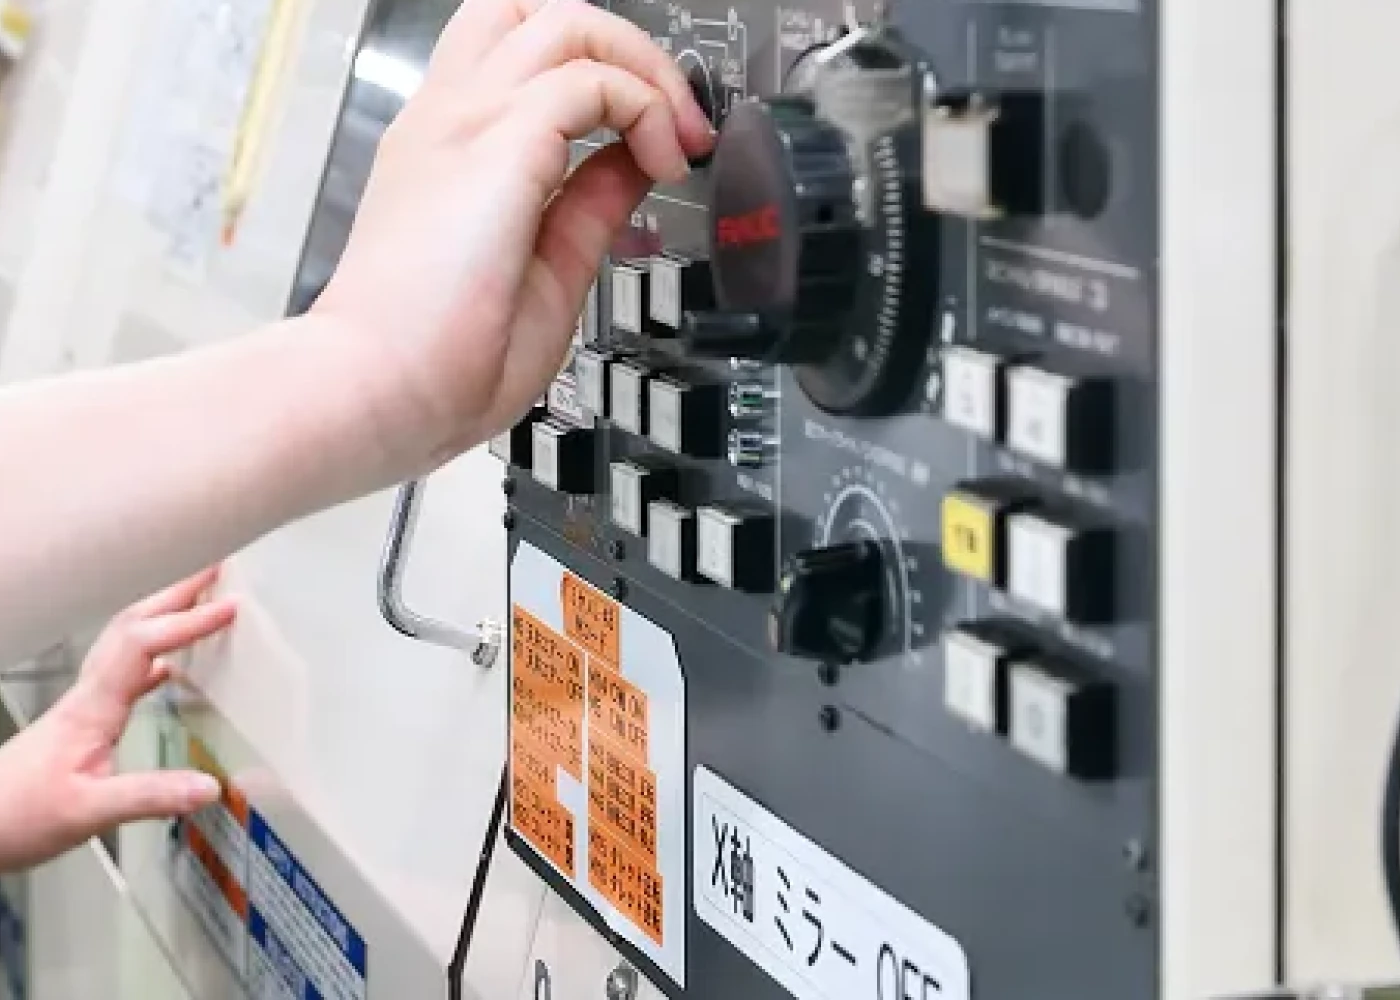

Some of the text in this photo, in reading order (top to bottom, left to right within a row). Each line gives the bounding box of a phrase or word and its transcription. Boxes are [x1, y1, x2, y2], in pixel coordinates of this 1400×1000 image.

[711, 812, 753, 923] X軸
[774, 865, 857, 967] ミラー
